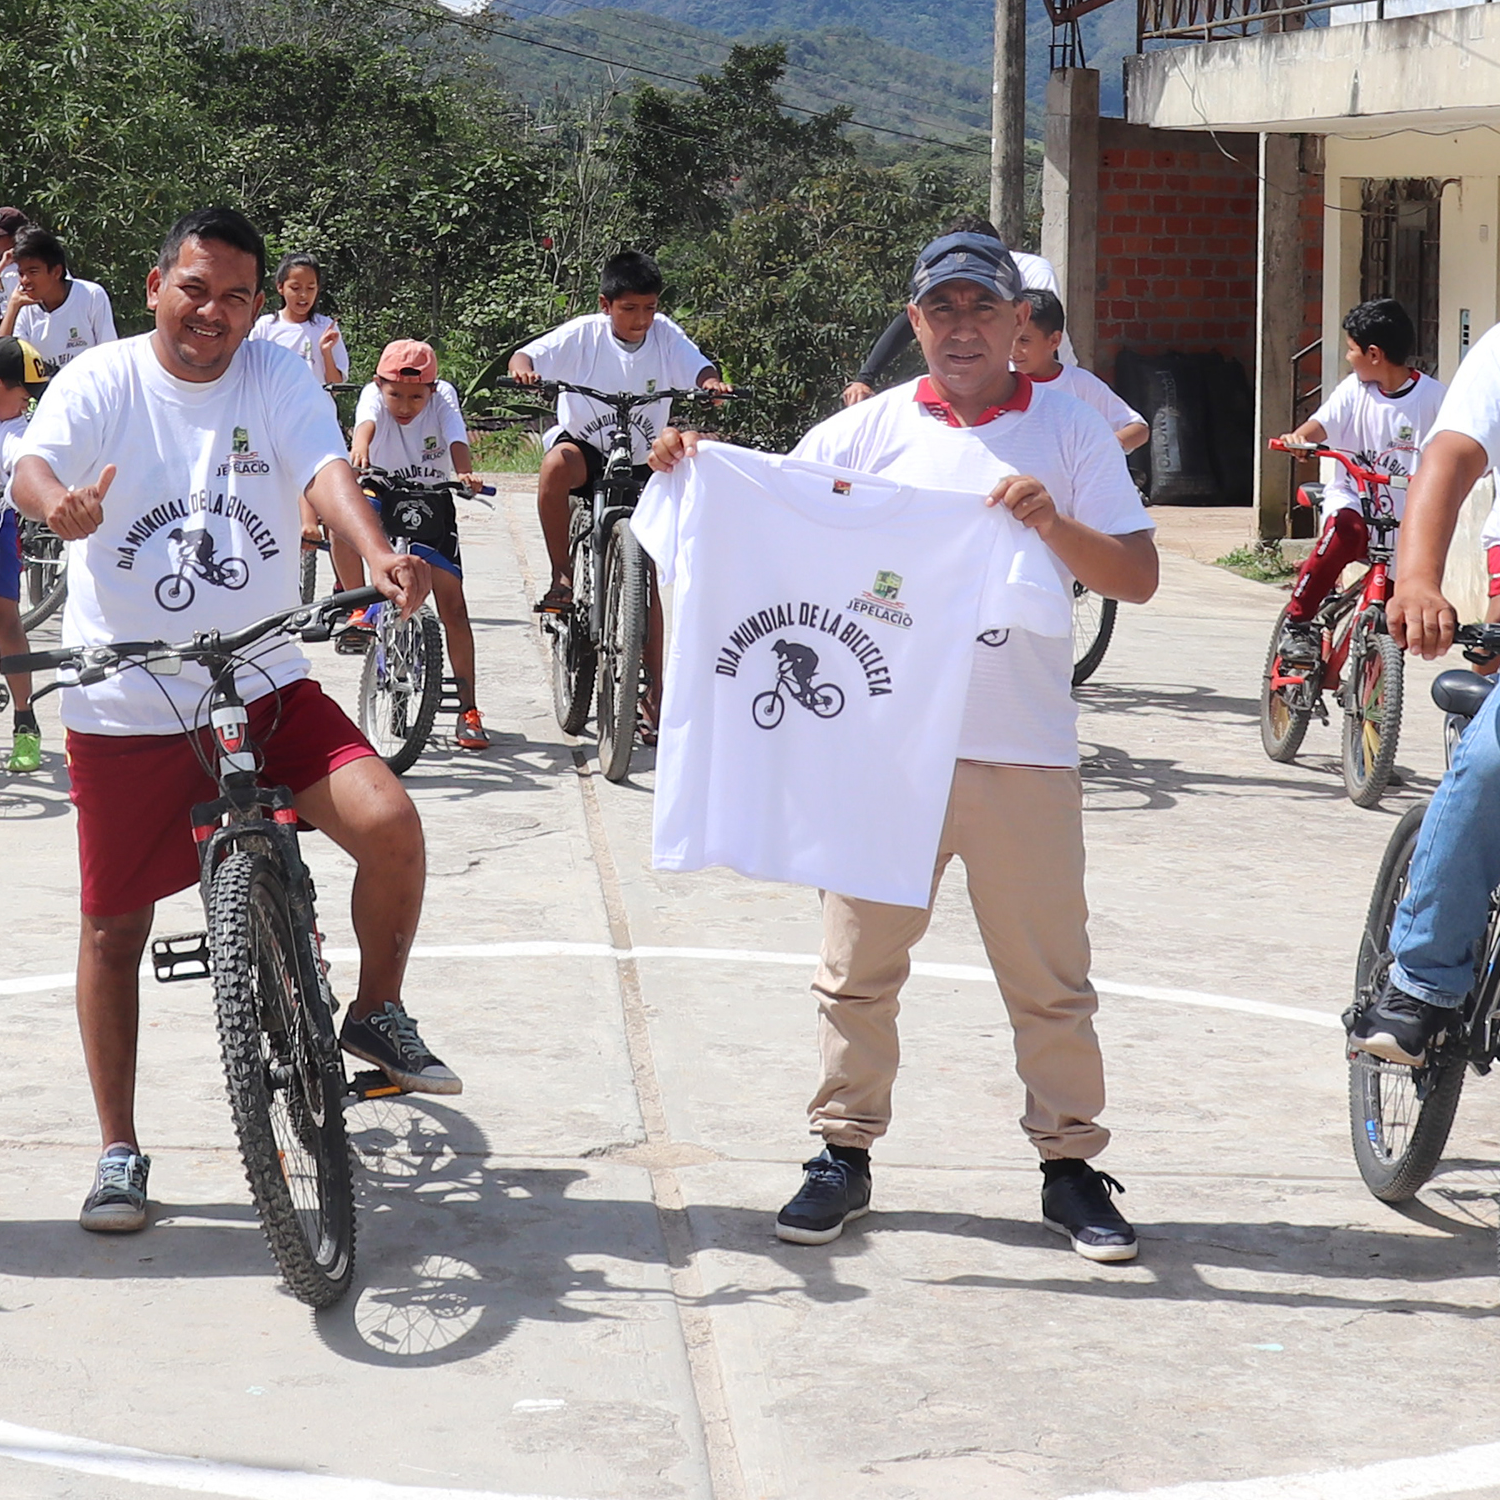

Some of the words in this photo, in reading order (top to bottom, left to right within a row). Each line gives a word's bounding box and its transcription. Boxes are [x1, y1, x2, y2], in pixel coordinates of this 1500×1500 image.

[216, 462, 270, 477] JEELACIO
[190, 489, 207, 514] DE
[208, 490, 223, 516] LA
[125, 498, 189, 547] MUNDIAL
[225, 495, 280, 561] BICICLETA
[117, 546, 138, 571] DIA
[846, 600, 913, 627] JEPELACIO
[715, 647, 741, 678] DIA
[729, 602, 795, 654] MUNDIAL
[799, 601, 820, 628] DE
[820, 608, 843, 637] LA
[838, 621, 893, 697] BICICLETA
